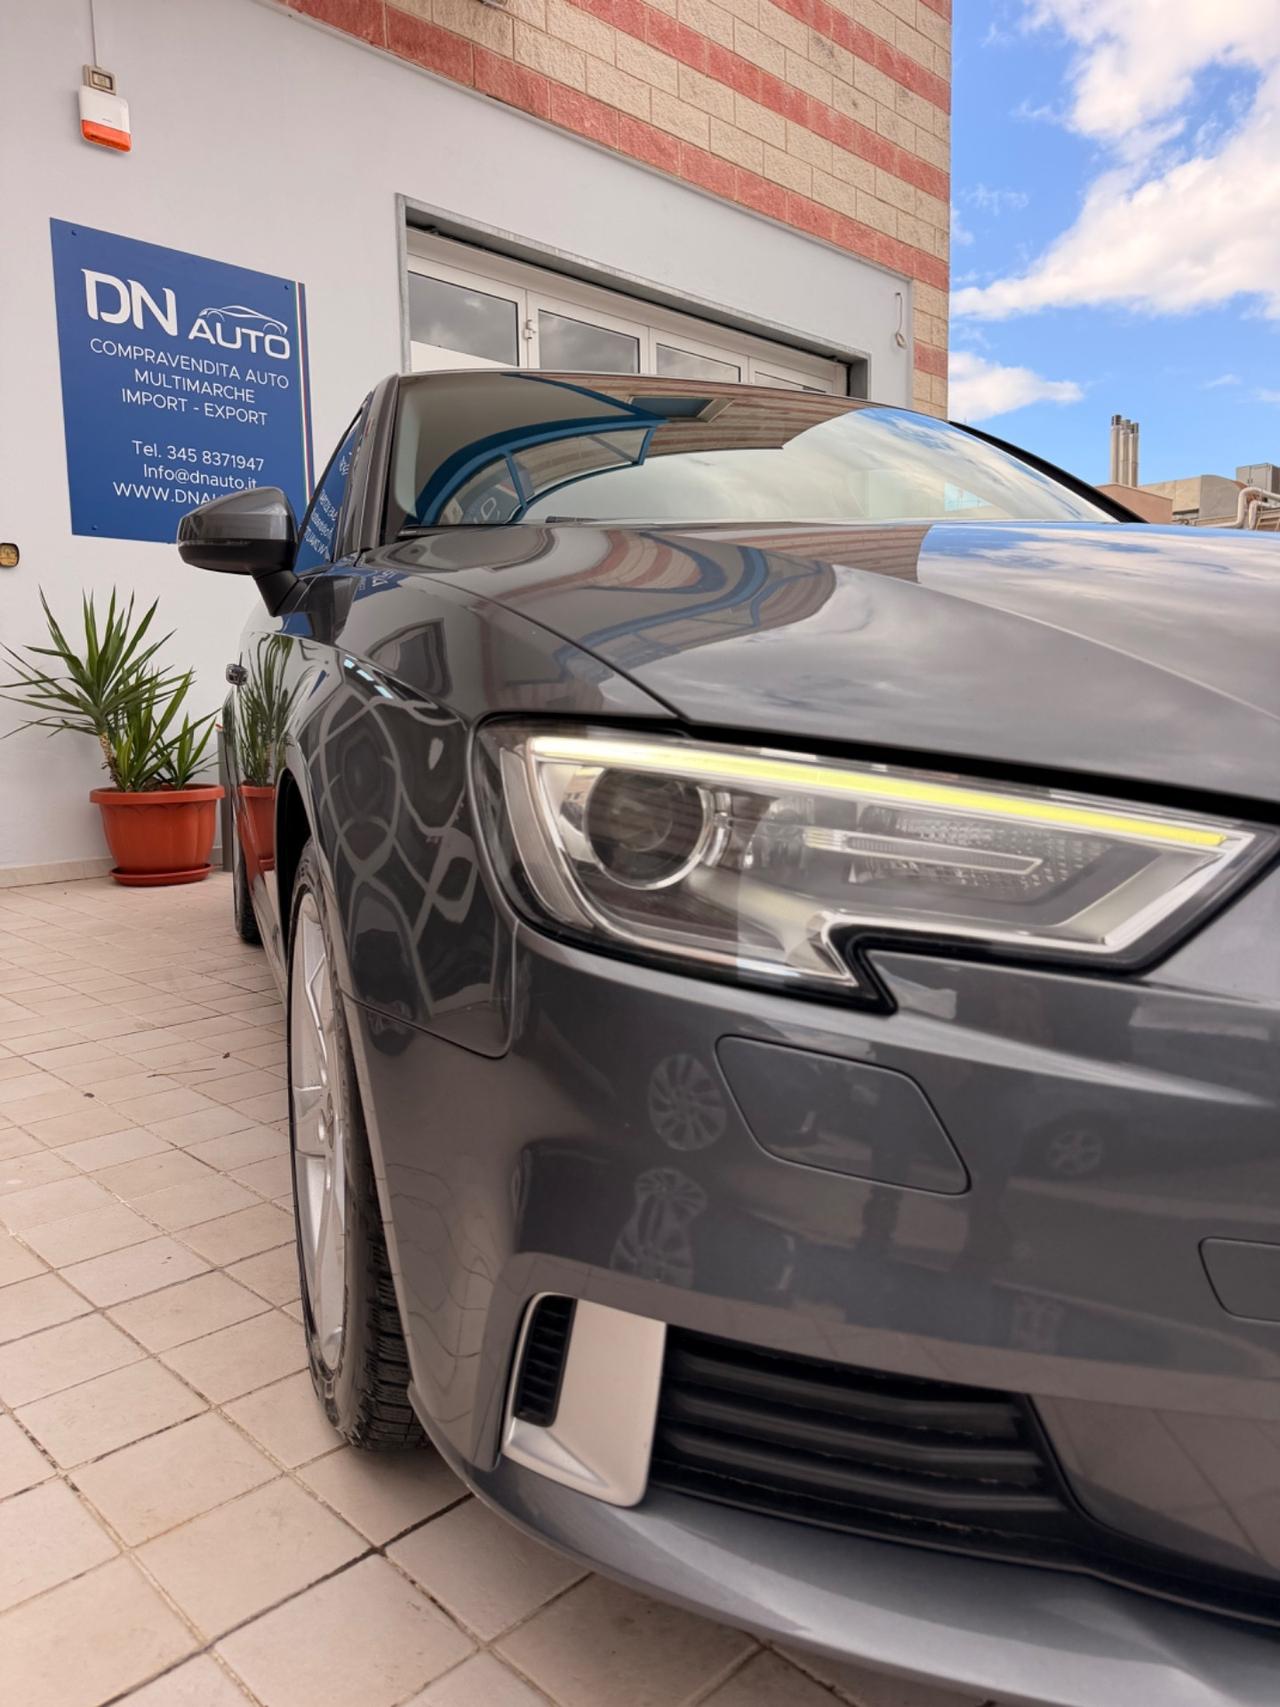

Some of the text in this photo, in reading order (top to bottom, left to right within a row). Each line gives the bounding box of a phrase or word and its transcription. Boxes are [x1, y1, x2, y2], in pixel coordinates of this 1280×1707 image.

[81, 268, 291, 361] DN AUTO
[90, 337, 289, 389] COMPRAVENDITA AUTO
[134, 368, 256, 403] MULTIMARCHE
[121, 388, 188, 412] IMPORT
[204, 402, 268, 426] EXPORT
[132, 439, 265, 472] Tel. 345 8371947
[112, 481, 218, 505] WWW.DNA
[143, 463, 257, 490] Info@dnauto.it
